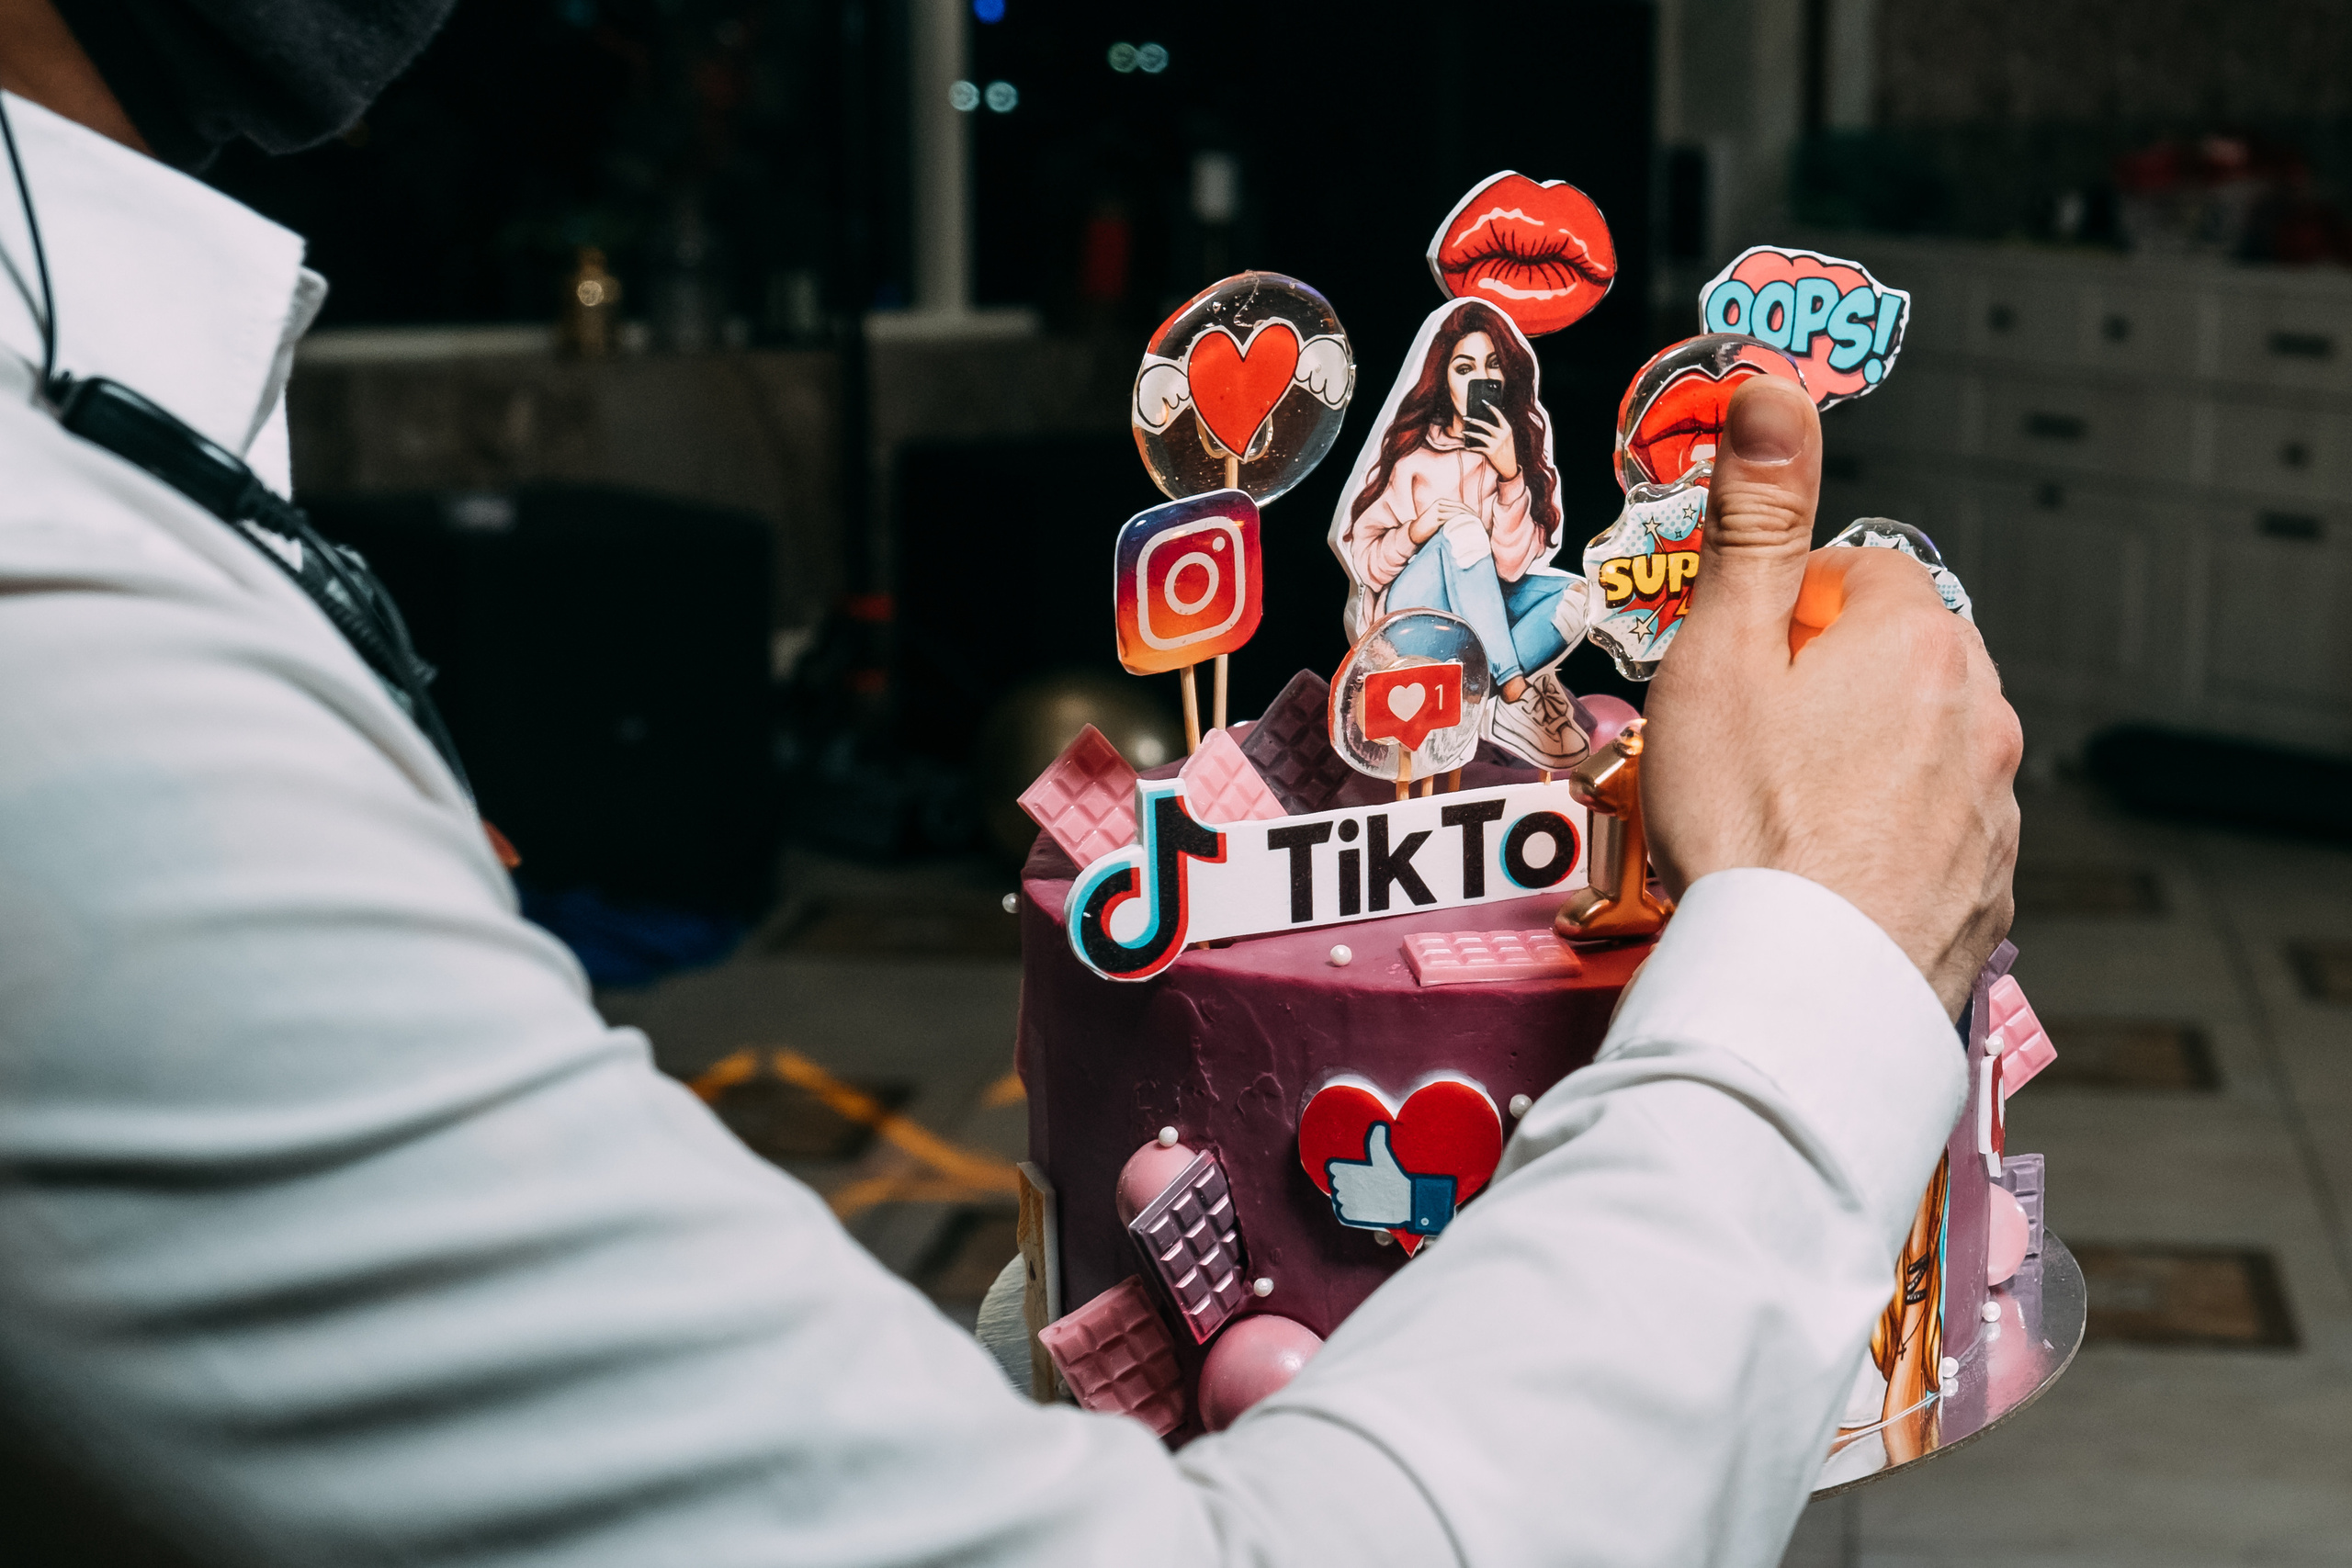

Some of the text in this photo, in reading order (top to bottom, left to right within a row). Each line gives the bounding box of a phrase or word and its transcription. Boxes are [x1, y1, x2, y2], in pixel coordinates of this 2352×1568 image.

[1706, 277, 1902, 384] OOPS!
[1599, 549, 1700, 609] SUP
[1434, 683, 1443, 710] 1
[1267, 797, 1582, 924] TikTo
